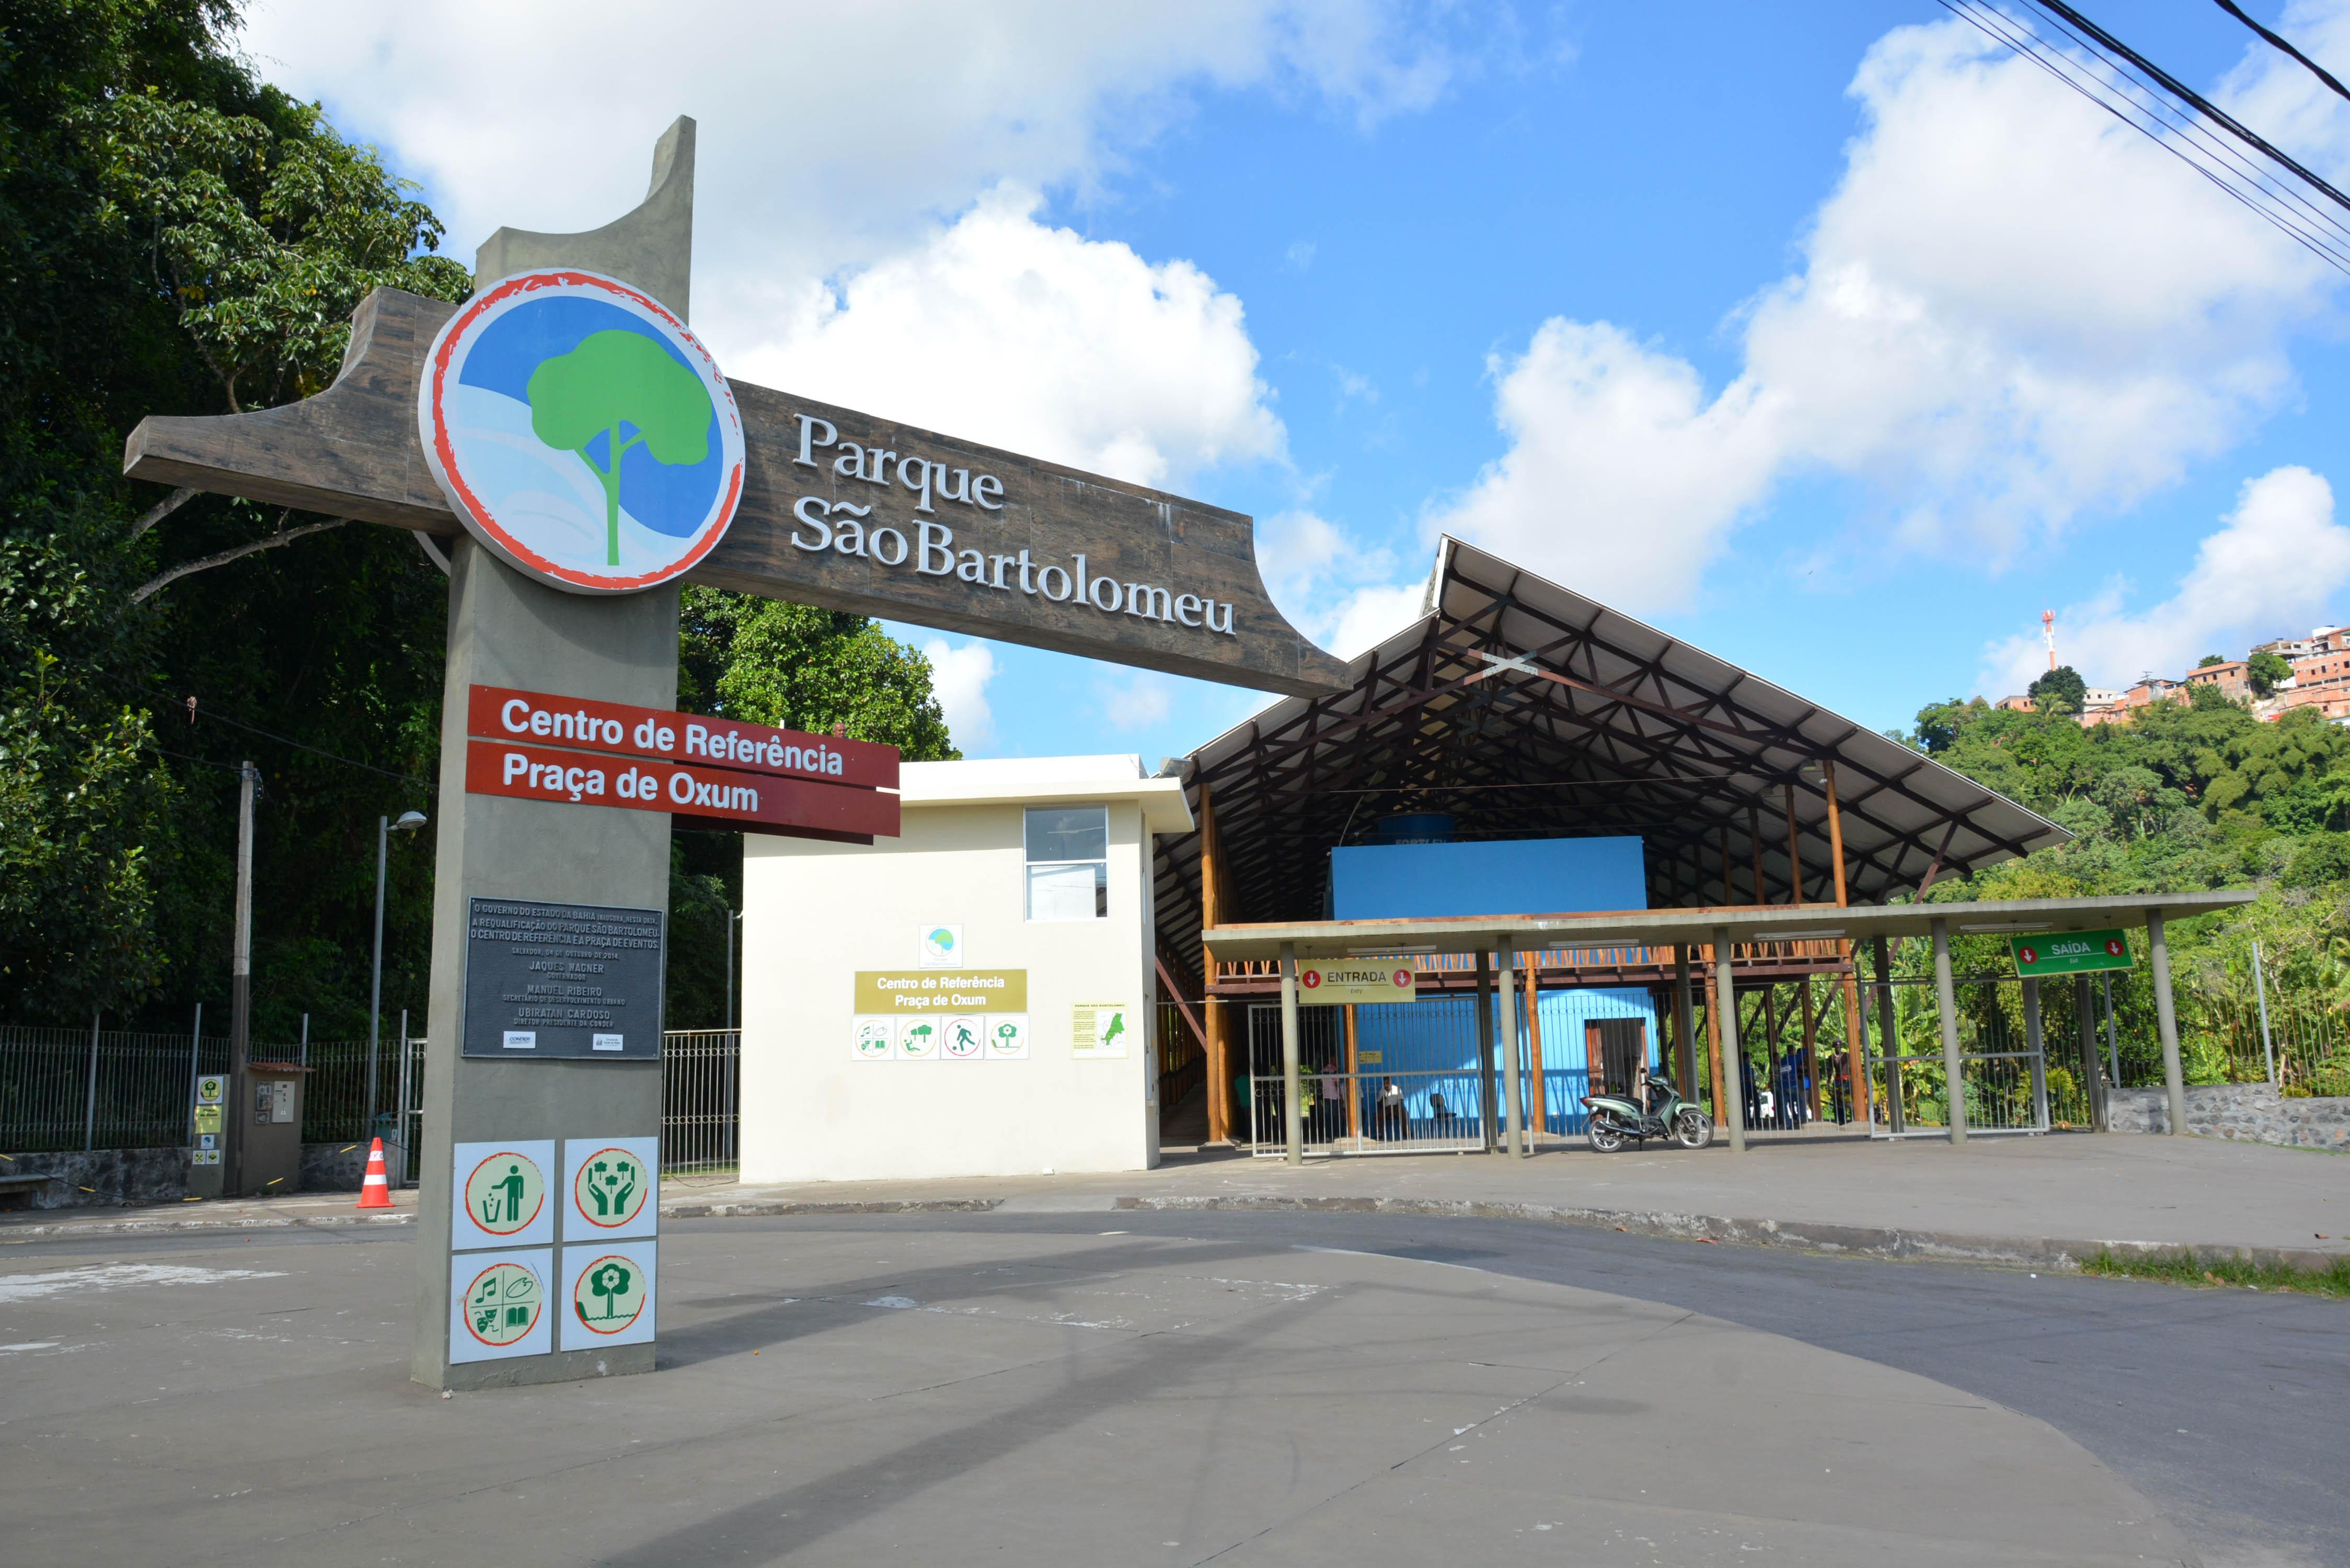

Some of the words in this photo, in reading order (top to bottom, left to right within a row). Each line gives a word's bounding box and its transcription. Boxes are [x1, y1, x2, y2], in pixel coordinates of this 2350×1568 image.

[793, 412, 1004, 514] Parque
[790, 496, 908, 567] São
[912, 520, 1236, 636] Bartolomeu
[501, 699, 624, 744] Centro
[634, 718, 675, 751] de
[685, 723, 843, 776] Referência
[503, 753, 605, 801] Praça
[616, 766, 658, 801] de
[669, 772, 758, 812] Oxum
[482, 905, 518, 915] GOVERNO
[532, 908, 560, 918] ESTADO
[573, 911, 595, 920] BAHIA
[480, 918, 545, 931] REQUALIFICAÇÃO
[547, 922, 557, 930] DO
[559, 923, 591, 933] PARQUE
[592, 923, 607, 934] SÃO
[471, 929, 476, 938] O
[478, 929, 511, 940] CENTRO
[512, 932, 522, 941] DE
[524, 931, 571, 944] REFERÊNCIA
[573, 936, 578, 944] E
[578, 936, 585, 945] A
[585, 937, 612, 948] PRAÇA
[613, 938, 623, 947] DE
[623, 939, 659, 949] EVENTOS.
[512, 948, 544, 957] SALVADOR,
[2051, 941, 2091, 955] SAÍDA
[529, 961, 564, 972] JAQUES
[569, 962, 604, 973] WAGNER
[547, 972, 586, 981] GOVERNADOR
[877, 977, 918, 989] Centro
[921, 977, 937, 989] de
[940, 976, 1005, 988] Referência
[1328, 972, 1386, 982] ENTRADA
[527, 985, 563, 995] MANUEL
[567, 986, 602, 996] RIBEIRO
[503, 994, 538, 1002] SECRETÁRIO
[549, 996, 601, 1005] DESENVOLVIMENTO
[895, 995, 929, 1009] Praça
[933, 995, 948, 1006] de
[951, 994, 986, 1006] Oxum
[519, 1008, 562, 1018] UBIRATAN
[568, 1009, 610, 1019] CARDOSO
